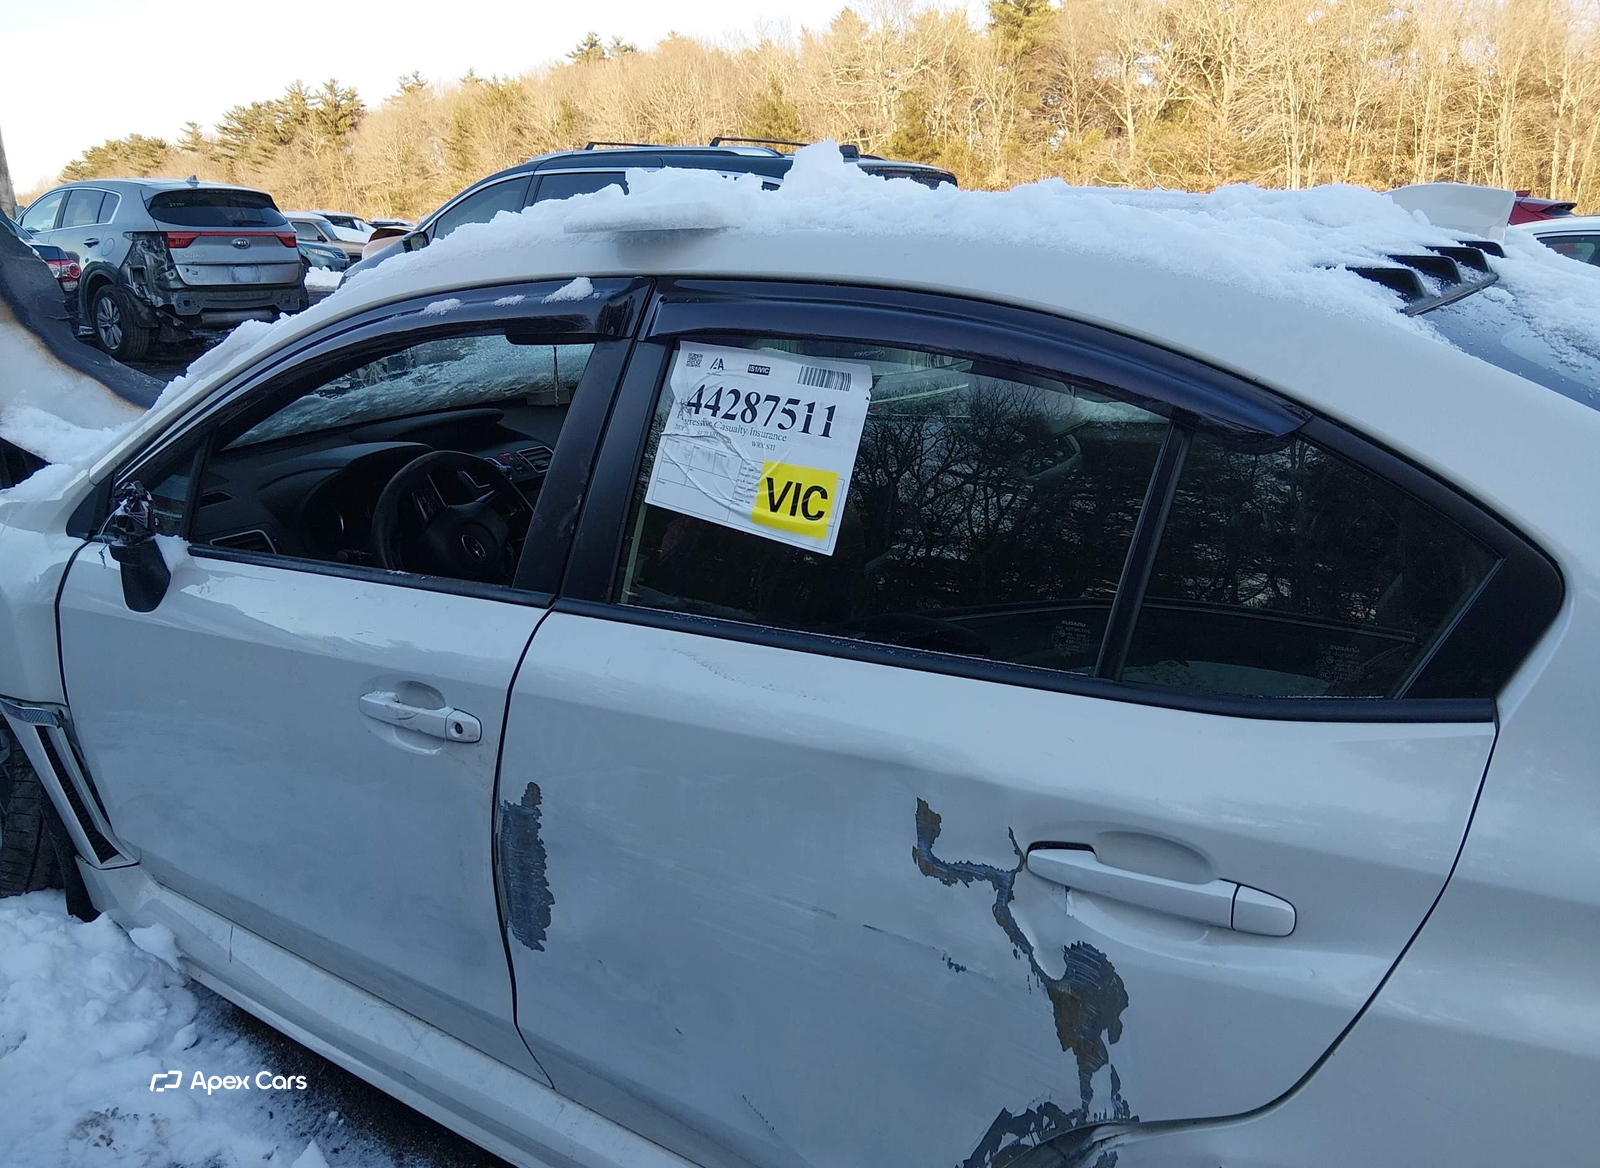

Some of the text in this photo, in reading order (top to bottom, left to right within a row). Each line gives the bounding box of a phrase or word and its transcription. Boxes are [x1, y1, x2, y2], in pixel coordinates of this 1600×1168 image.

[687, 384, 836, 438] 44287511
[714, 421, 748, 437] Casualty
[749, 426, 787, 442] Insurance
[766, 444, 776, 452] STI
[766, 477, 828, 521] VIC
